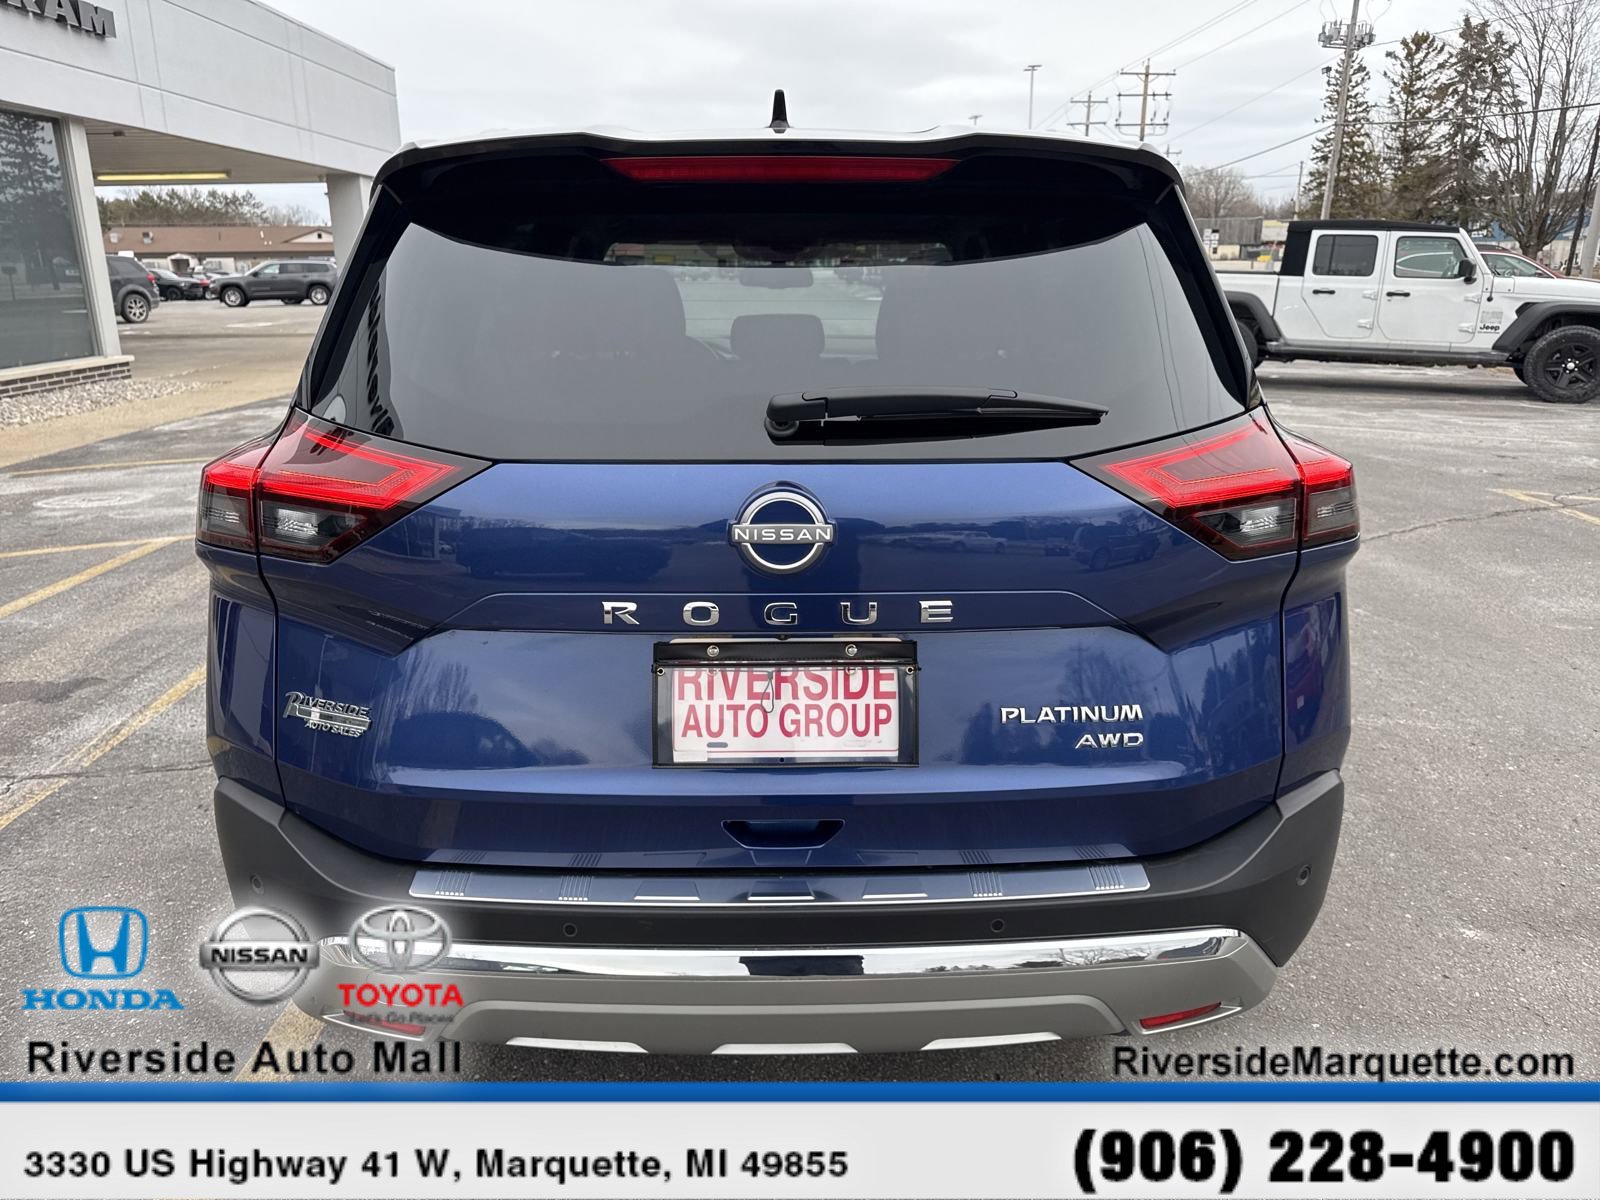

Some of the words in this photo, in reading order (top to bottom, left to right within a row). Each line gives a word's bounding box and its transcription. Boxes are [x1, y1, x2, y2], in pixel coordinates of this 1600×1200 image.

[734, 528, 831, 541] NISSAN
[602, 600, 954, 626] ROGUE
[677, 660, 897, 700] RIVERSIDE
[681, 703, 768, 738] AUTO
[779, 703, 892, 738] GROUP
[1000, 704, 1144, 724] PLATINUM
[304, 721, 331, 732] AUTO
[331, 724, 364, 738] SALES
[1075, 732, 1144, 749] AWD
